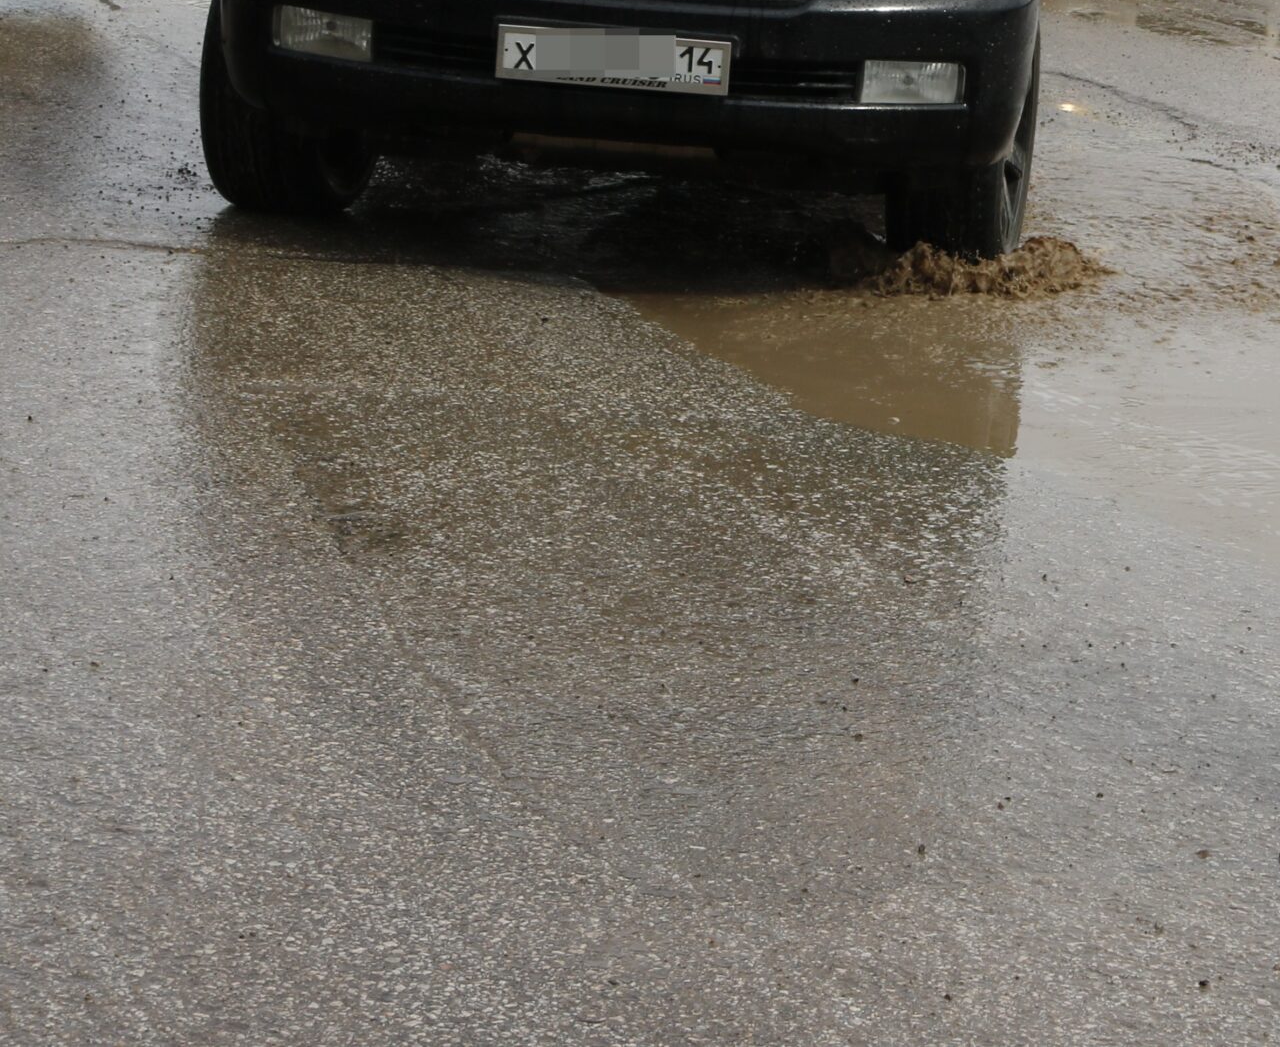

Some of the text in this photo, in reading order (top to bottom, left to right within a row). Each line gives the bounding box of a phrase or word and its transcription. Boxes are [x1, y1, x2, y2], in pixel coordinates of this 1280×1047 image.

[680, 46, 713, 74] 14
[600, 76, 668, 89] CRUISER
[675, 73, 701, 84] RUS
